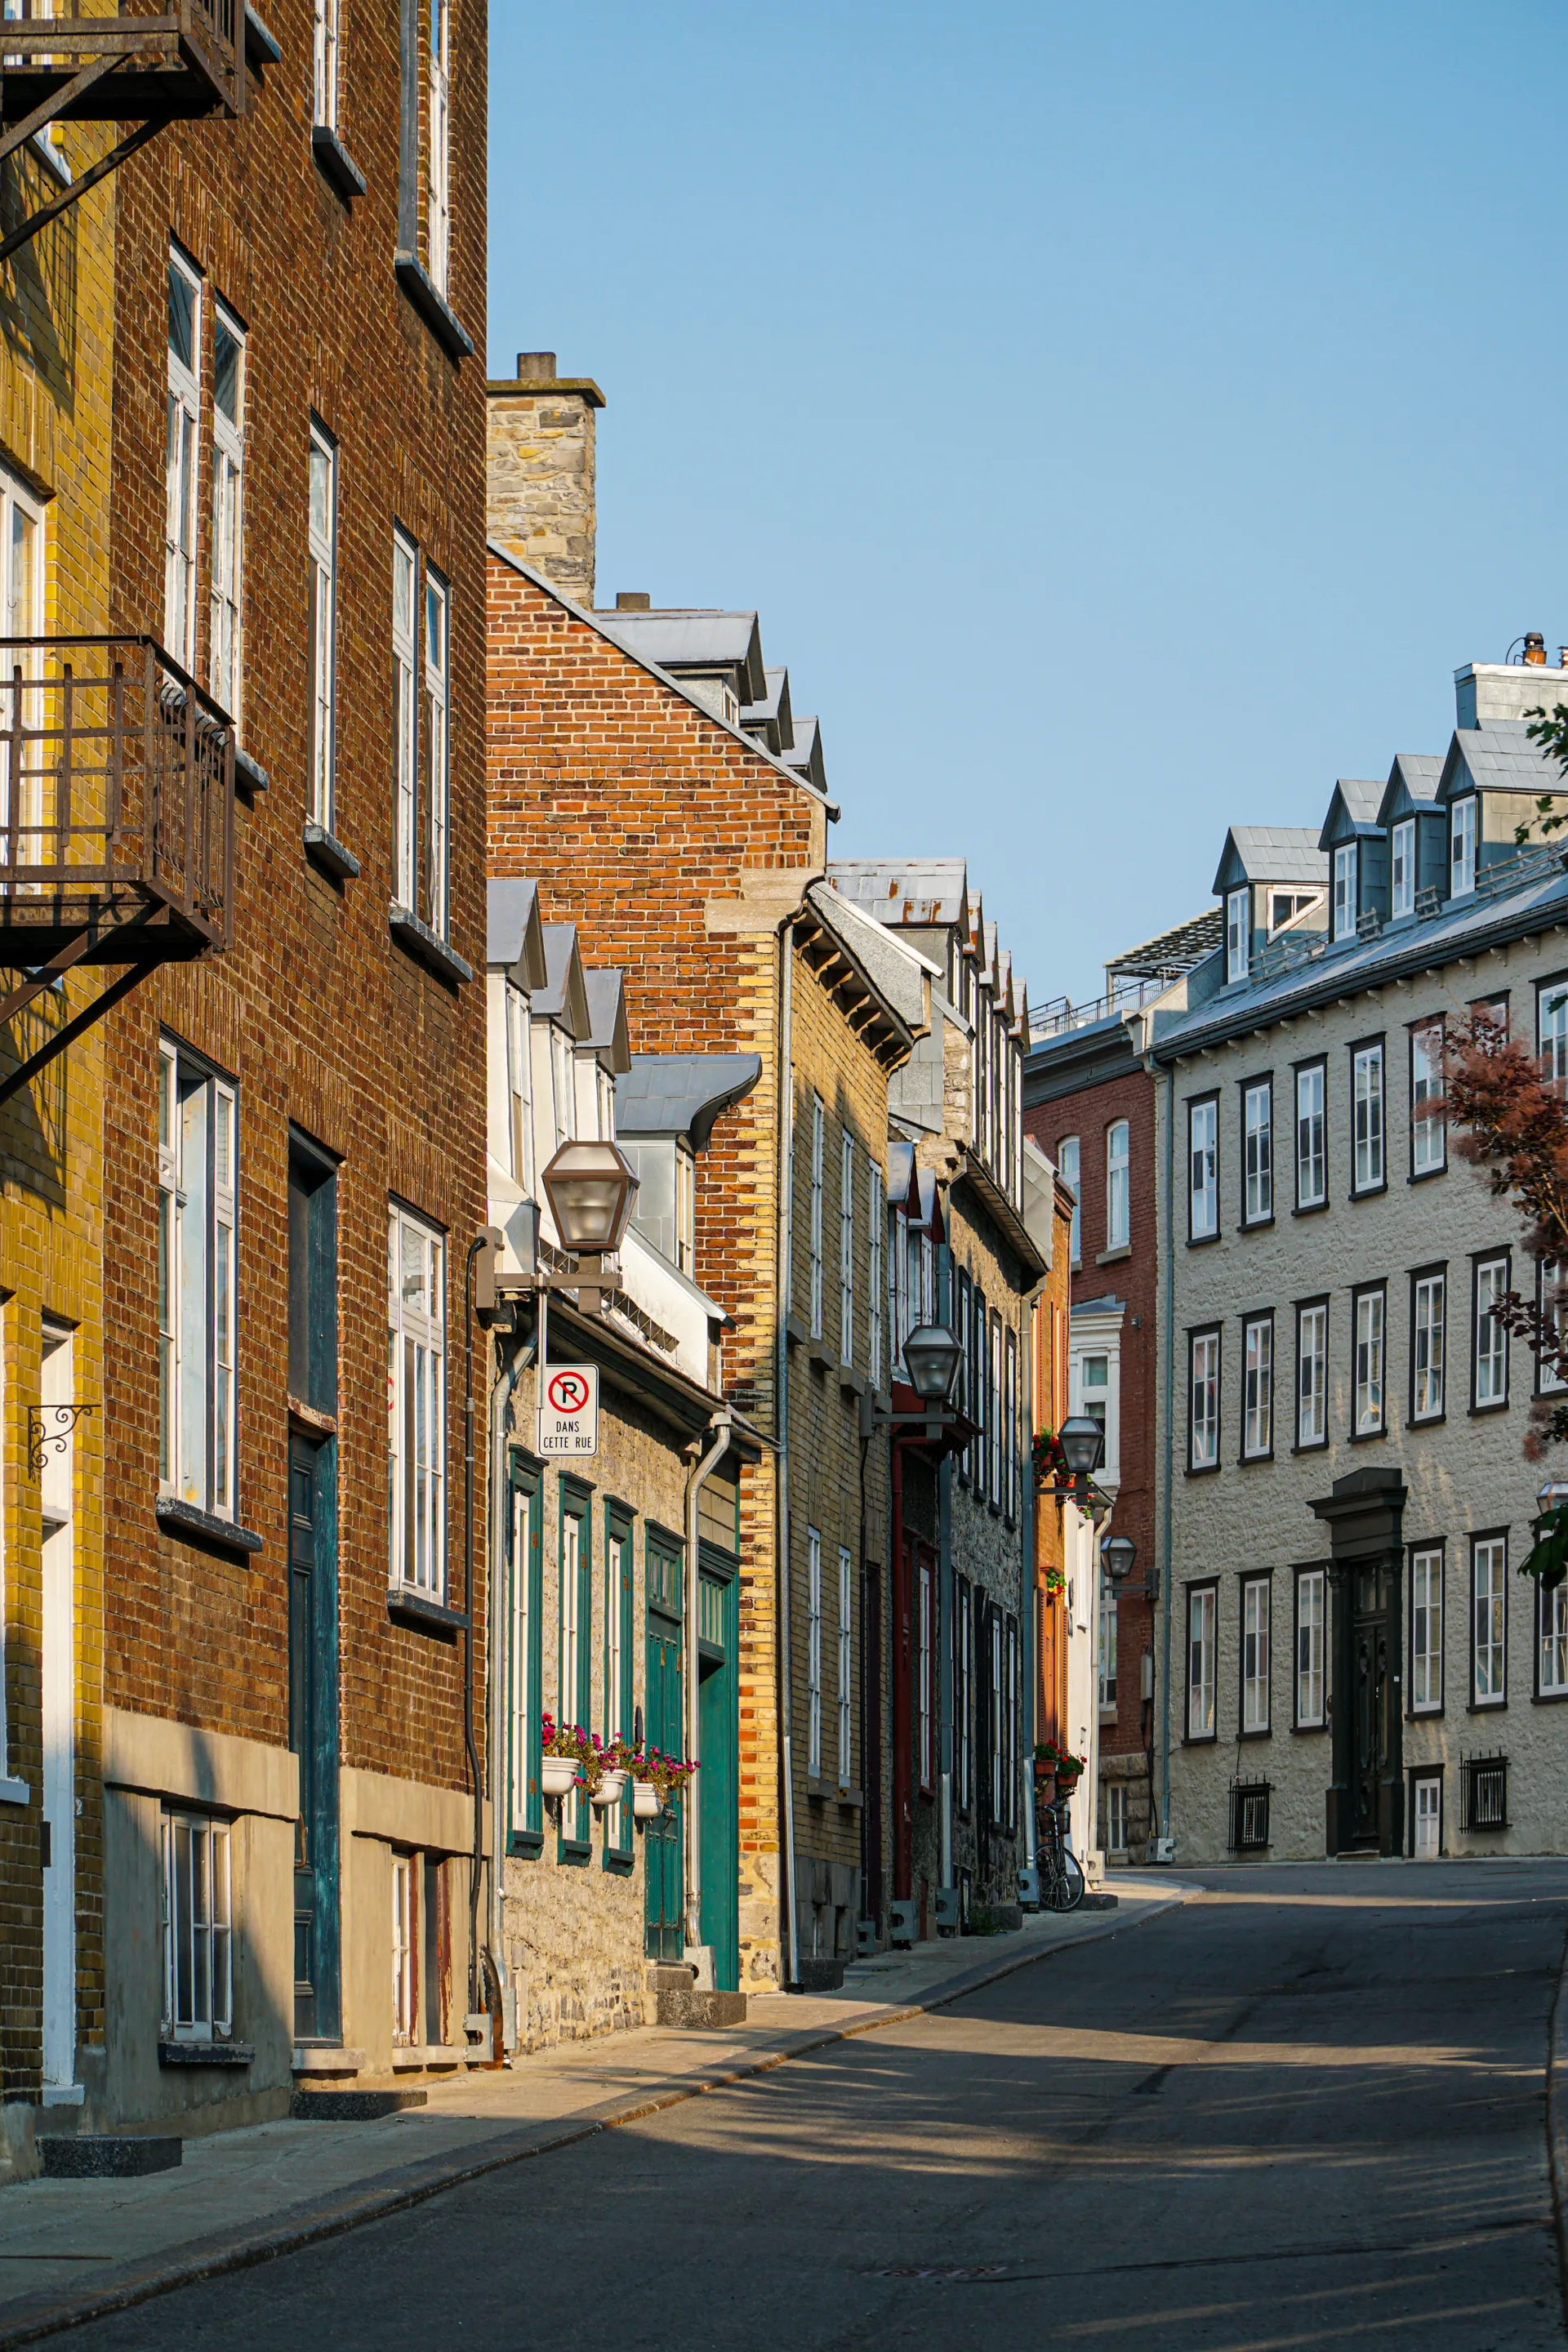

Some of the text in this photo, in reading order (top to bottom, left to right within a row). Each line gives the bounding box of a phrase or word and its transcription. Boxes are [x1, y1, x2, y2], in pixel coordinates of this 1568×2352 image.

[563, 1382, 577, 1403] P
[556, 1421, 579, 1432] DANS
[543, 1437, 592, 1448] CETTE RUE
